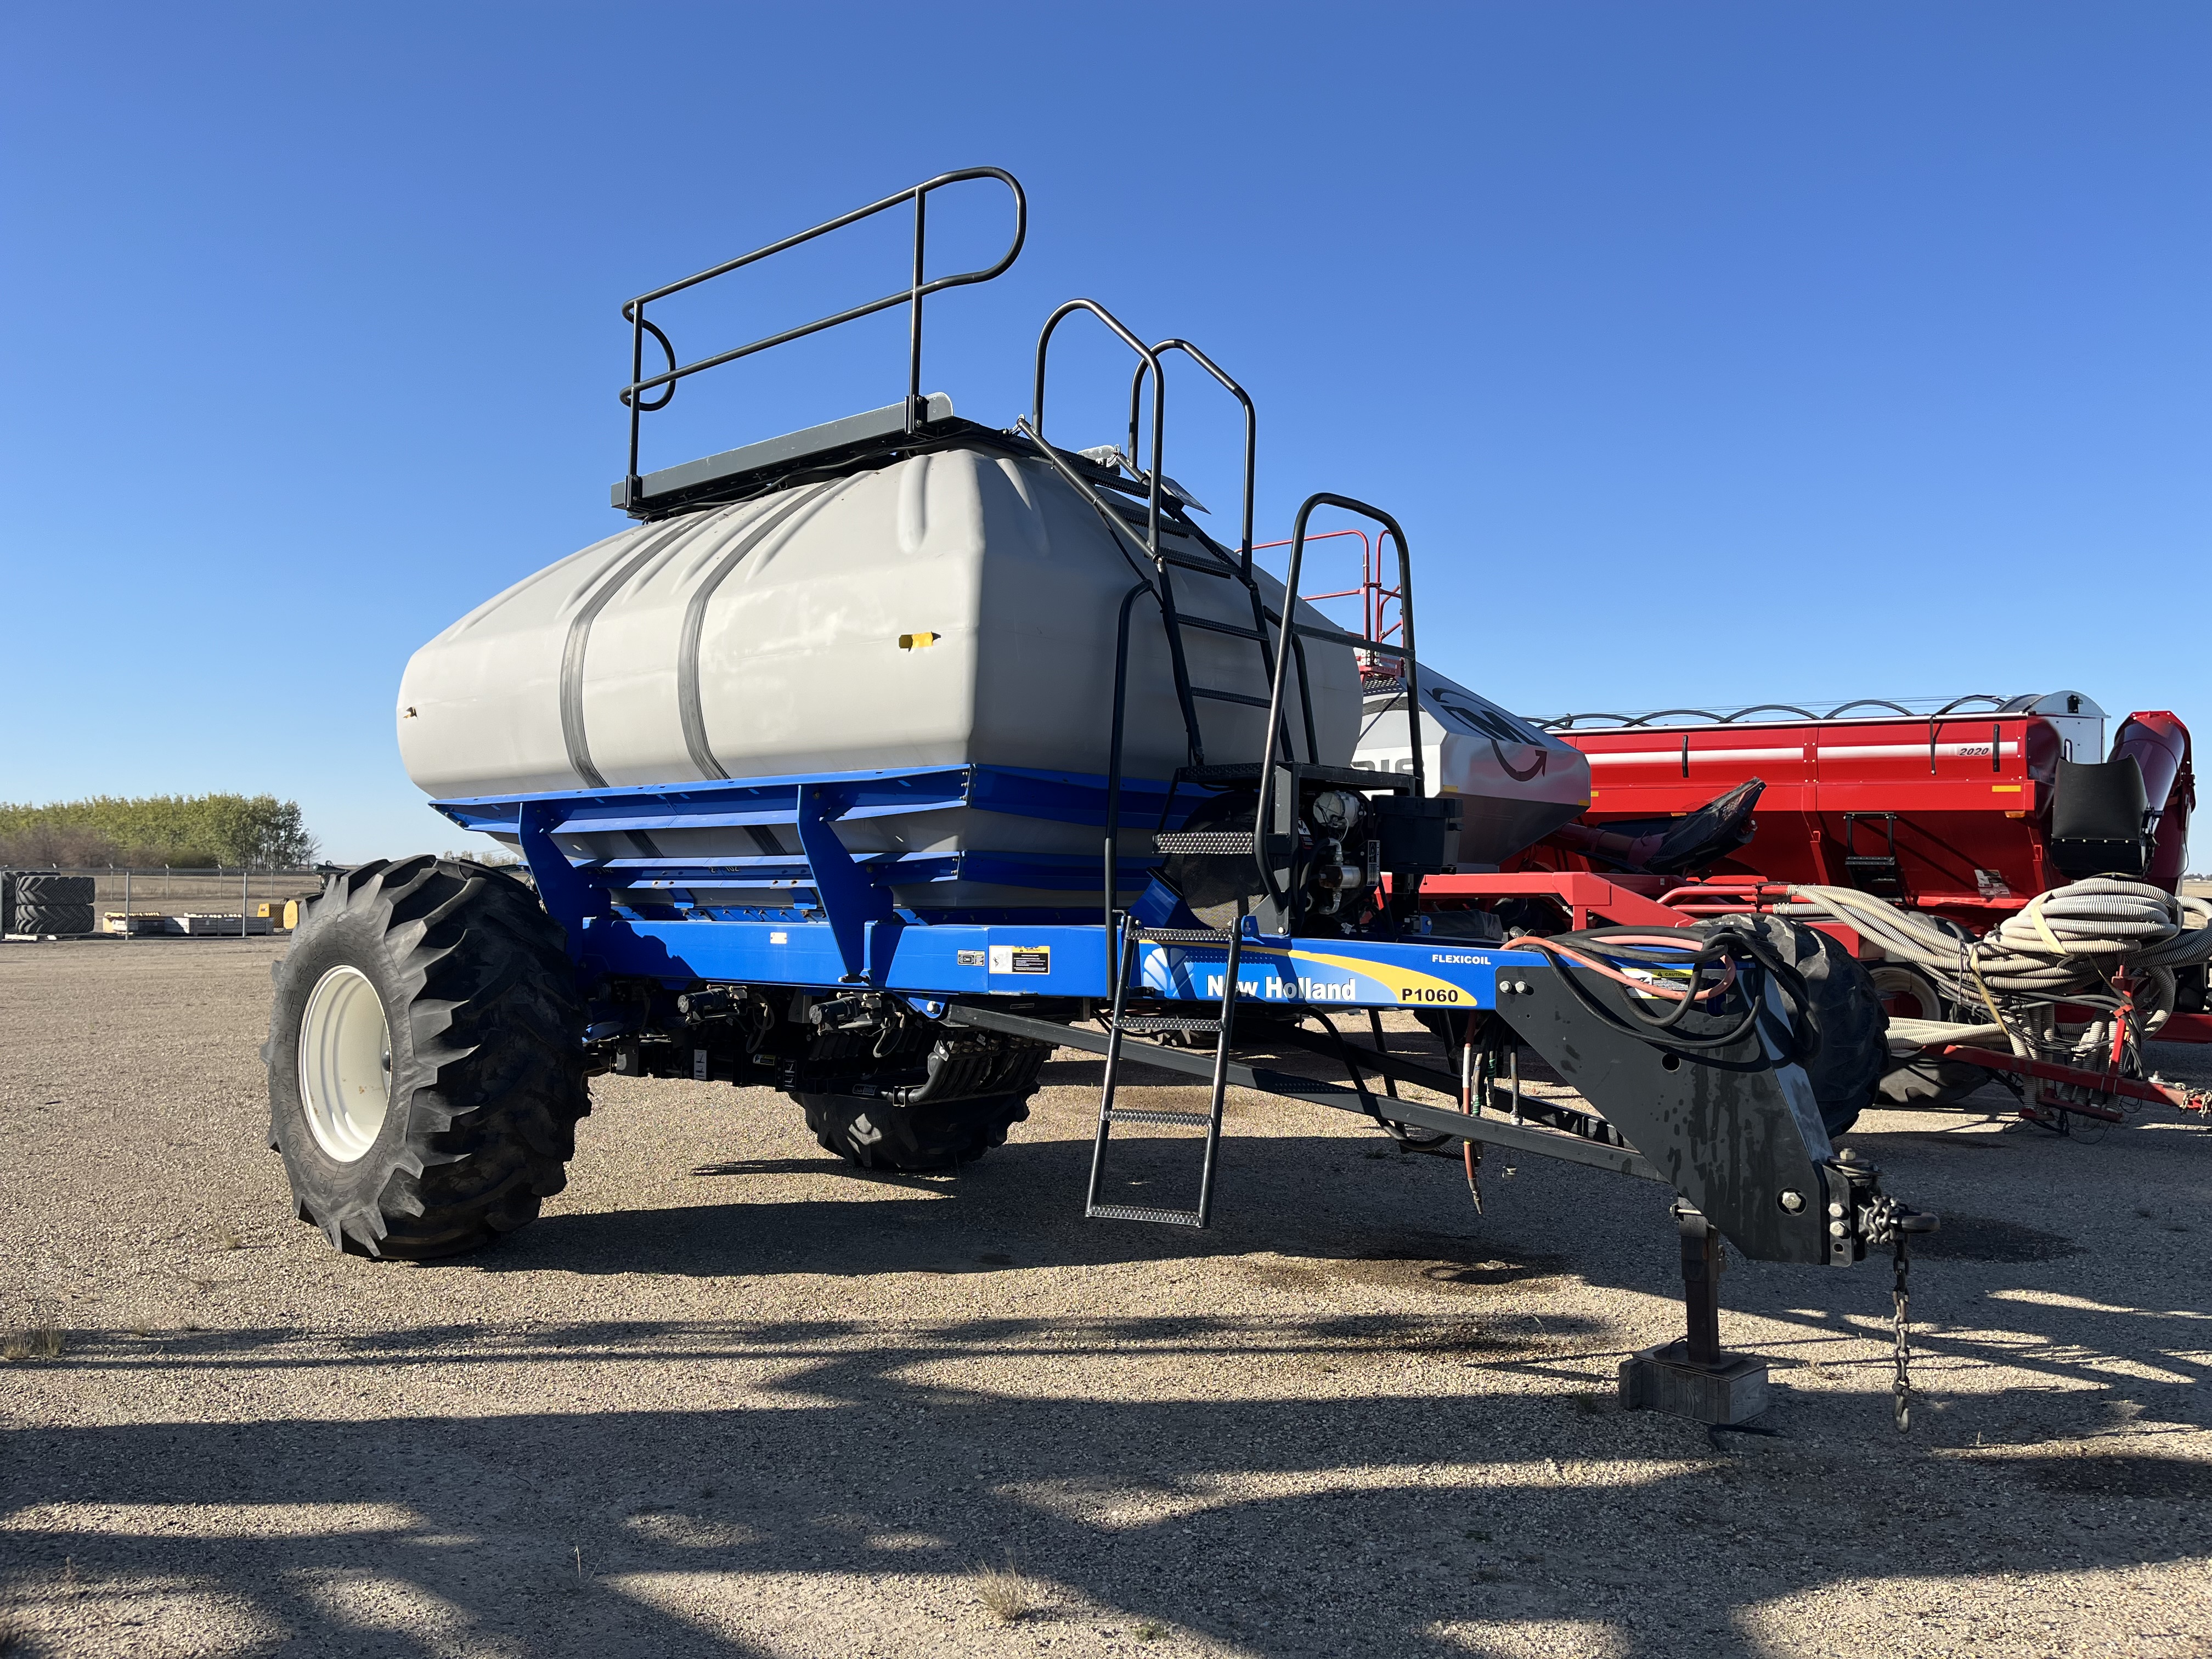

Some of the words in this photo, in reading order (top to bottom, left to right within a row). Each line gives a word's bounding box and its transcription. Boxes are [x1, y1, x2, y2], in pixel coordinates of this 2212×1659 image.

[1959, 747, 1989, 756] 2020
[1432, 954, 1491, 965] FLEXICOIL
[1207, 974, 1259, 997] Nw
[1265, 975, 1356, 1001] Holland
[1402, 988, 1458, 1002] P1060
